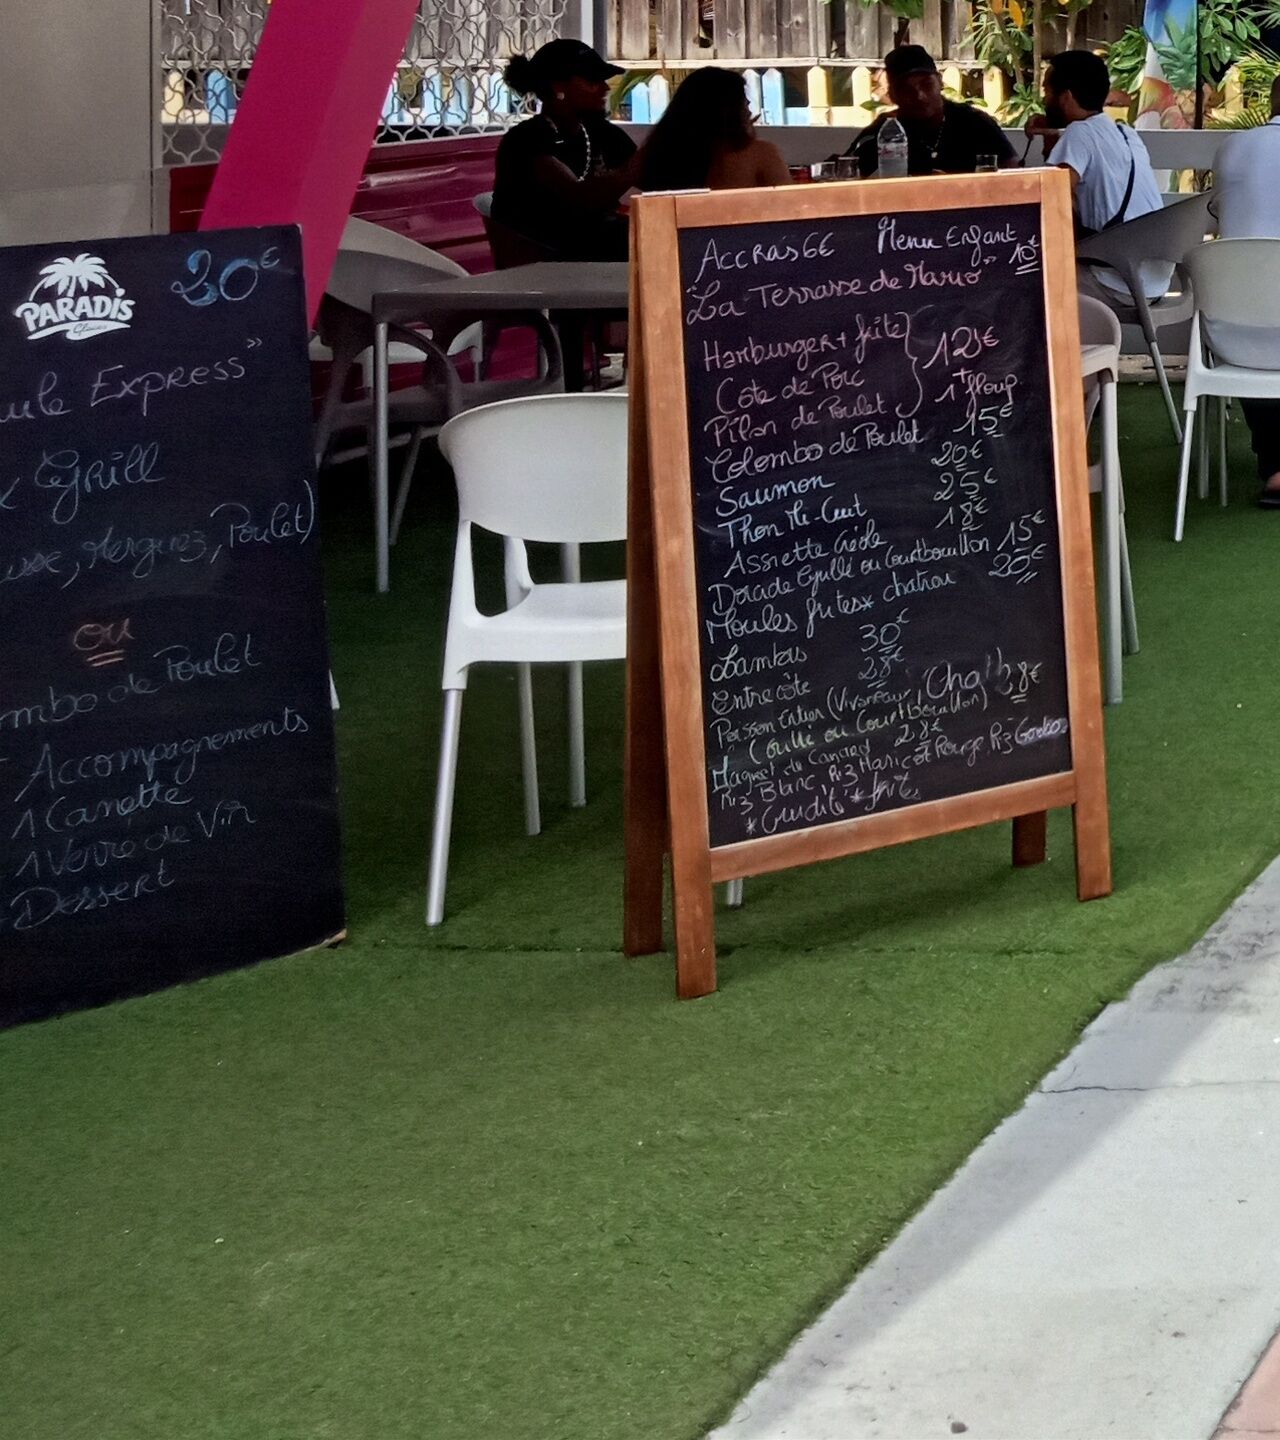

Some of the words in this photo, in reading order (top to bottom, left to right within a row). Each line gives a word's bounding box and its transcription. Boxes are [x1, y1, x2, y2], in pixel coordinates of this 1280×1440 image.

[878, 215, 943, 254] Menu
[946, 223, 1018, 267] Enfant
[170, 247, 280, 306] 20€
[748, 277, 867, 309] Terrasse
[869, 268, 902, 293] de
[14, 288, 136, 333] PARADIS
[0, 371, 72, 423] ule
[781, 376, 815, 399] de
[812, 362, 866, 390] Porc
[791, 405, 819, 430] de
[818, 392, 888, 419] Poulet
[705, 440, 824, 484] Colombo
[829, 432, 861, 454] de
[853, 419, 925, 449] Poulet
[715, 476, 837, 517] Saumon
[717, 514, 785, 549] Thon
[723, 538, 830, 578] Assiette
[708, 577, 796, 616] Dorade
[706, 604, 798, 644] Moules
[0, 687, 98, 728] mbo
[108, 674, 160, 703] de
[153, 632, 261, 681] Poulet
[14, 707, 310, 801] Accompagnements
[46, 785, 194, 833] Canette
